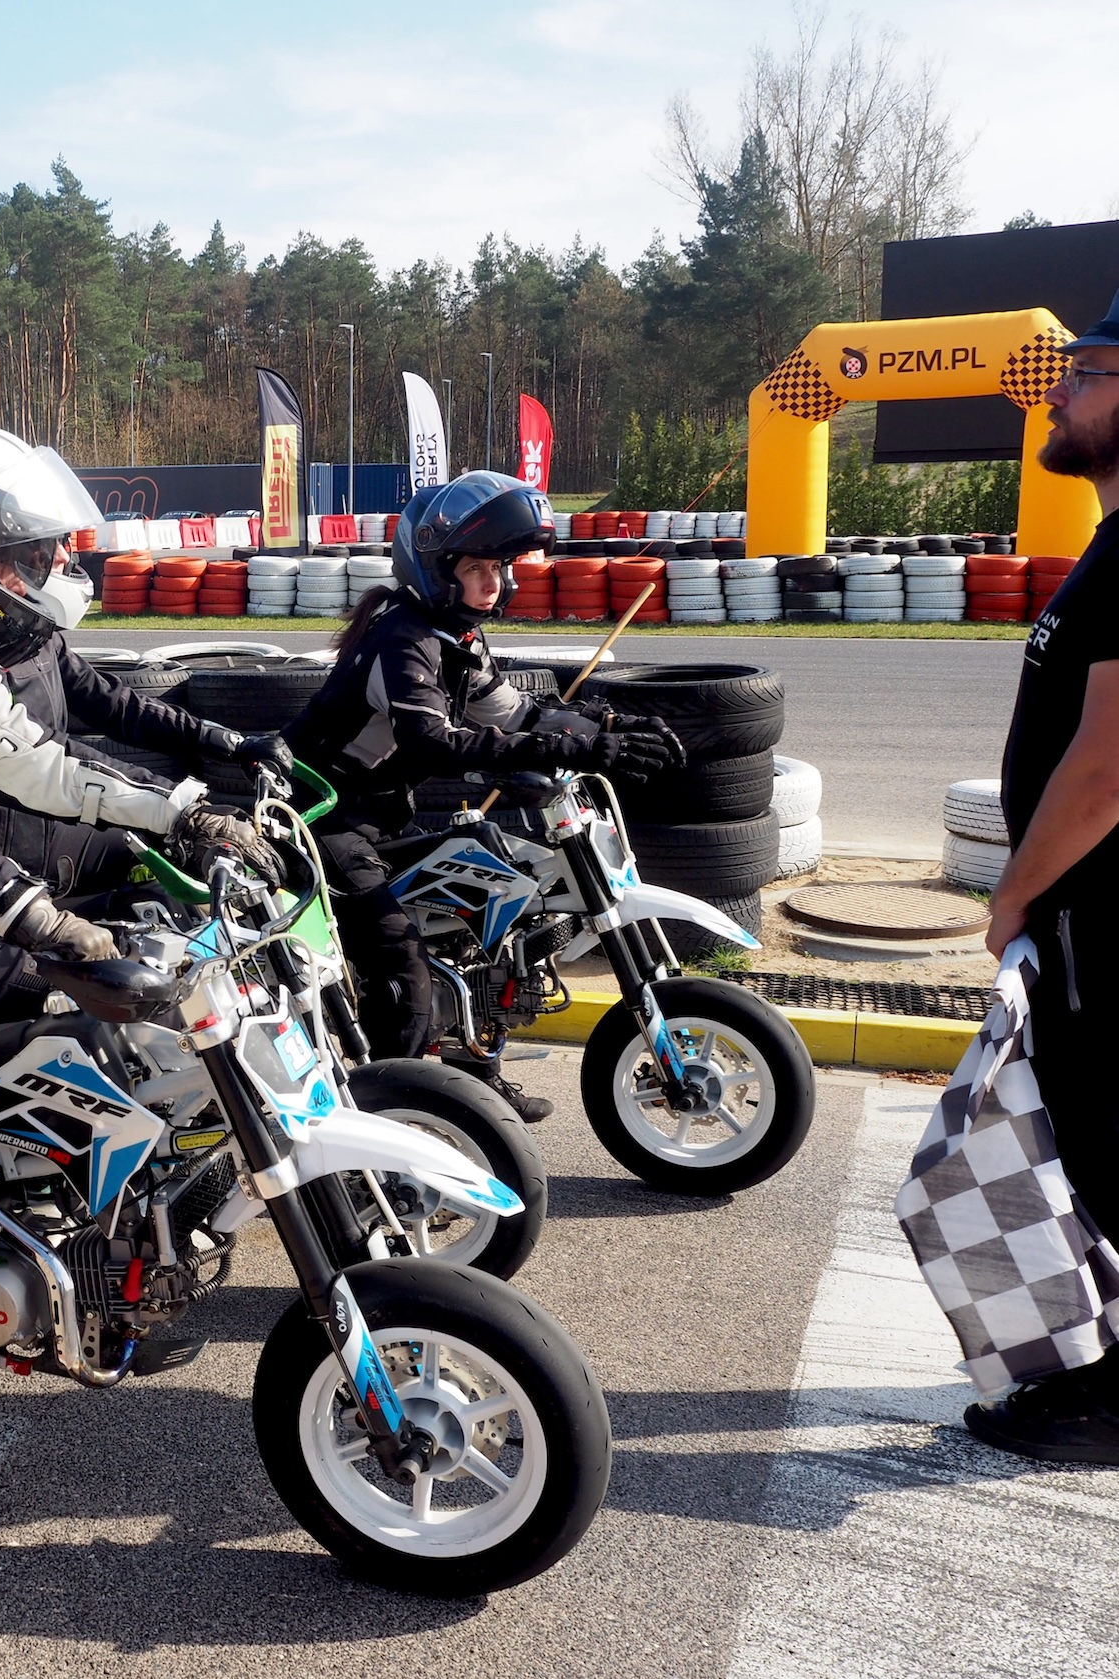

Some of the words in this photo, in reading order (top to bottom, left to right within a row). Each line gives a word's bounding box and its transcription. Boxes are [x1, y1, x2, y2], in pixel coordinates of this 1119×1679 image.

[879, 347, 986, 374] PZM.PL
[845, 371, 863, 379] PZM
[432, 860, 518, 883] MRF
[414, 899, 457, 913] SUPERMOTO
[12, 1073, 133, 1119] MRF
[335, 1300, 348, 1333] KAYO
